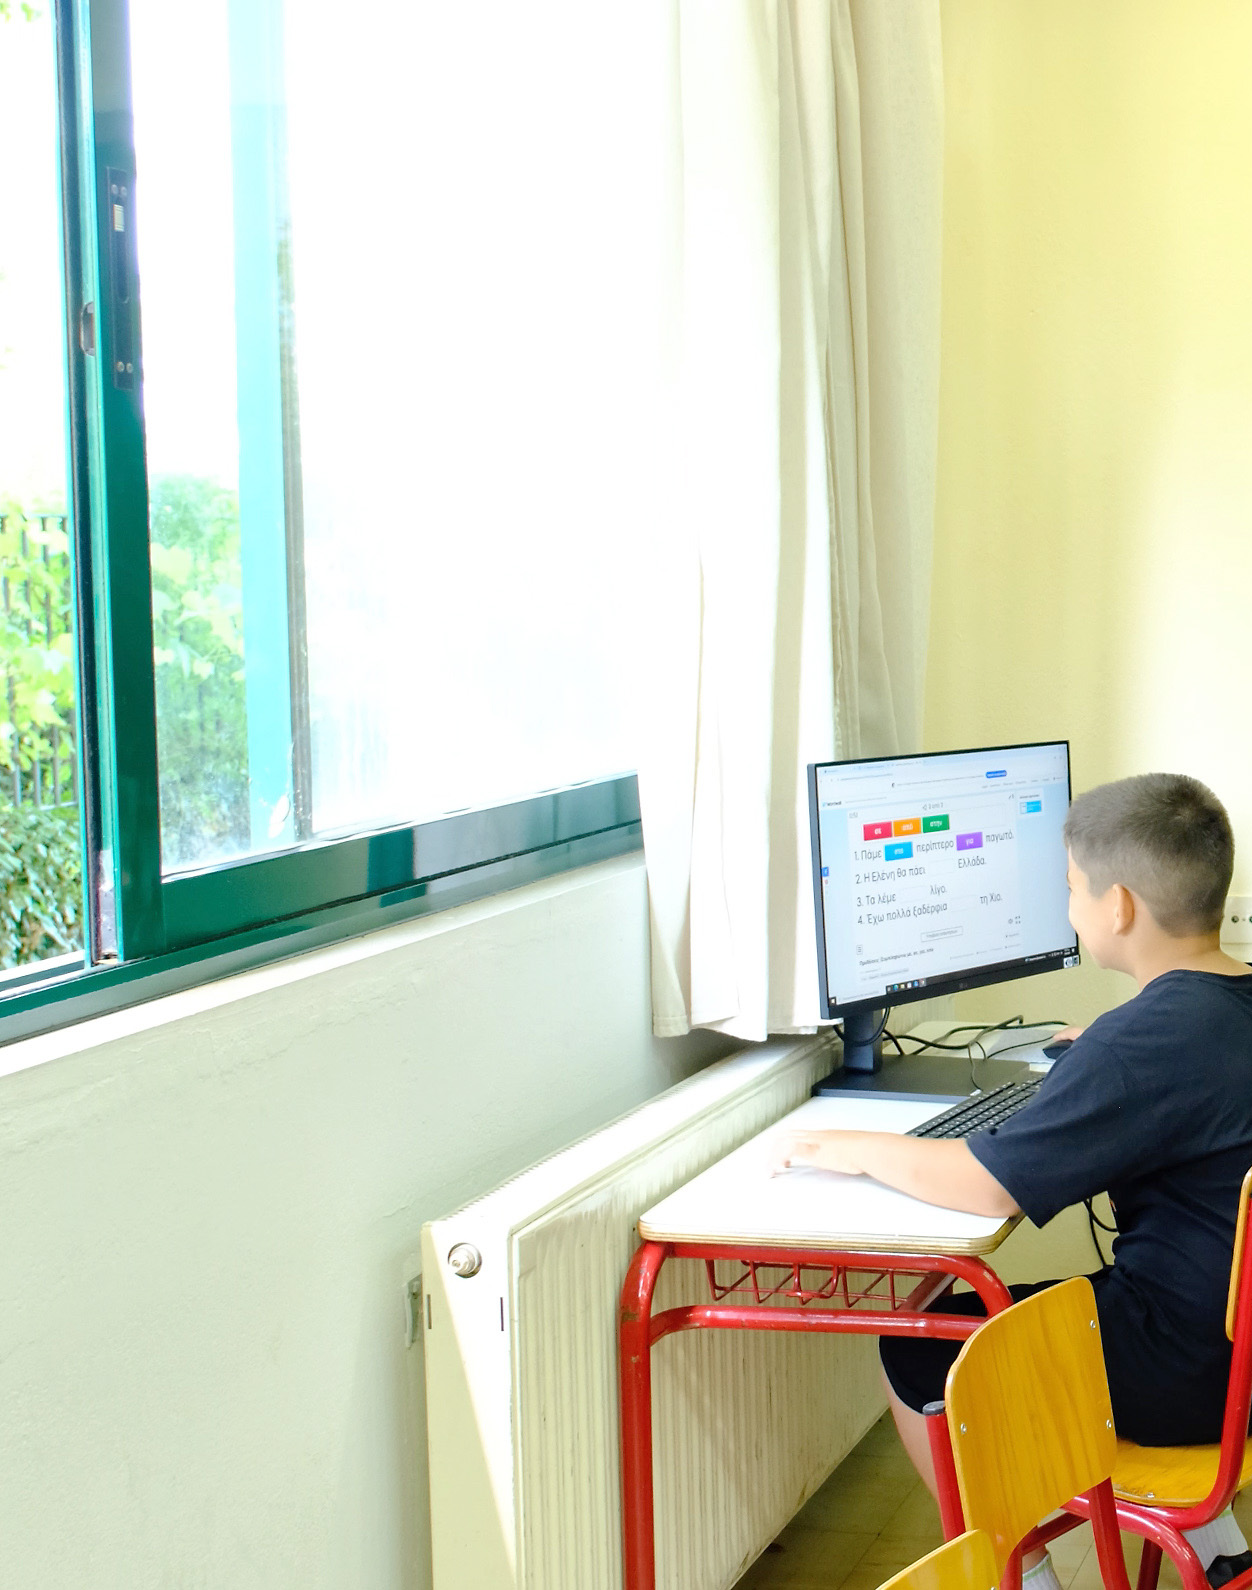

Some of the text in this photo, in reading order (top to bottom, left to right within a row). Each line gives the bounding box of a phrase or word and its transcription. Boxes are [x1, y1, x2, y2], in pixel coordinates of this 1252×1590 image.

[861, 849, 882, 860] Πάμε
[916, 840, 954, 853] περίπτερο
[985, 830, 1014, 843] παγωτό.
[872, 870, 895, 882] Ελένη
[897, 867, 907, 877] θα
[865, 895, 875, 905] Τα
[878, 893, 896, 904] λέμε
[886, 907, 911, 921] πολλά
[913, 903, 948, 918] ξαδέρφια
